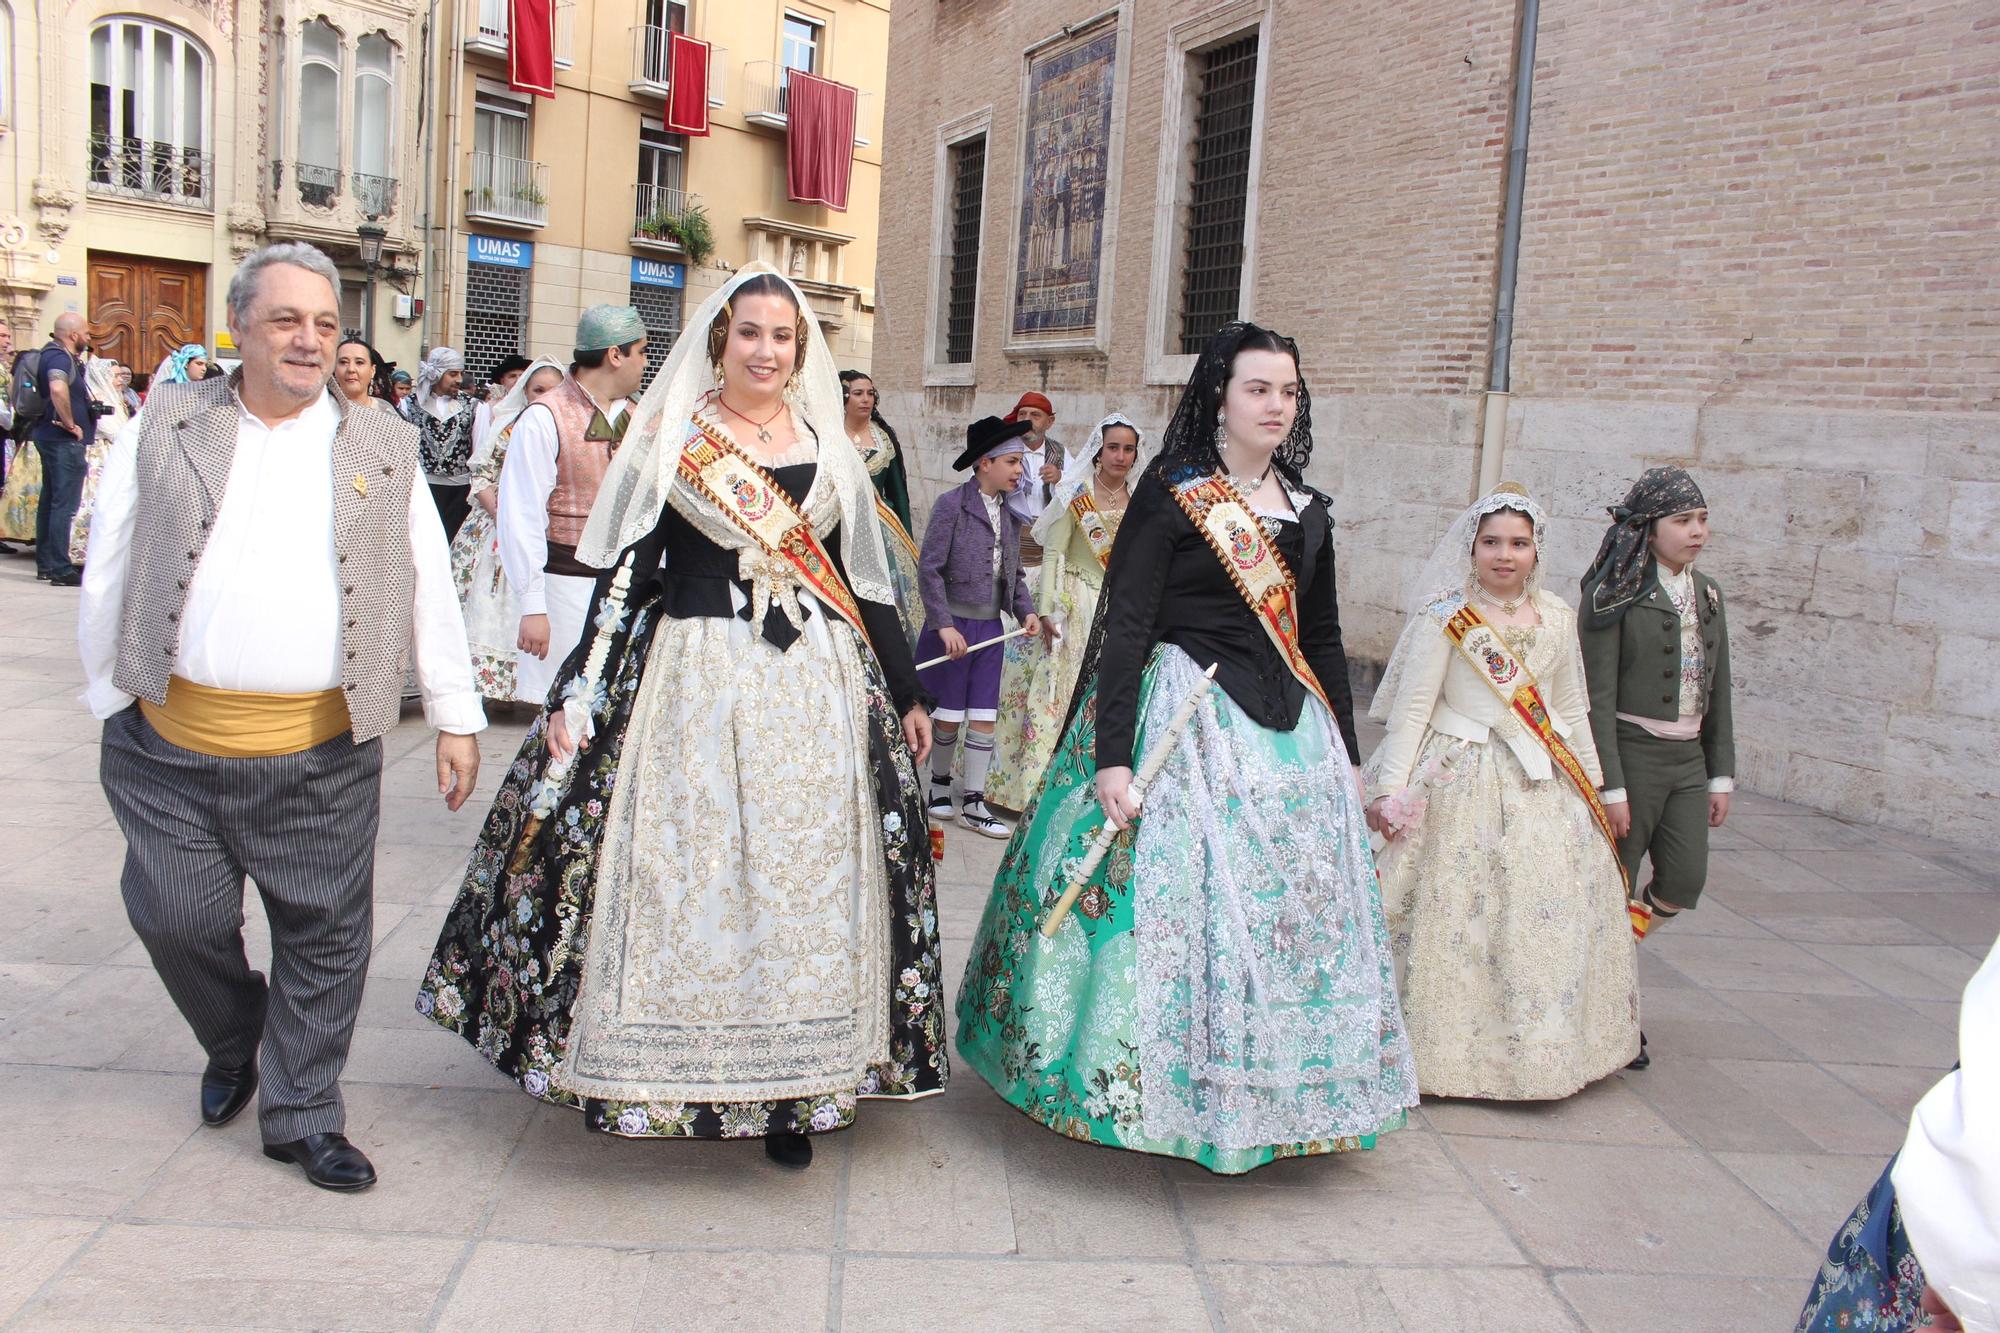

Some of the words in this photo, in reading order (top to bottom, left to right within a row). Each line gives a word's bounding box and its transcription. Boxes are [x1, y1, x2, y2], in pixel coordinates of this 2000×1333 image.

[477, 237, 520, 258] UMAS
[639, 260, 675, 279] UMAS
[1469, 633, 1491, 653] 2022
